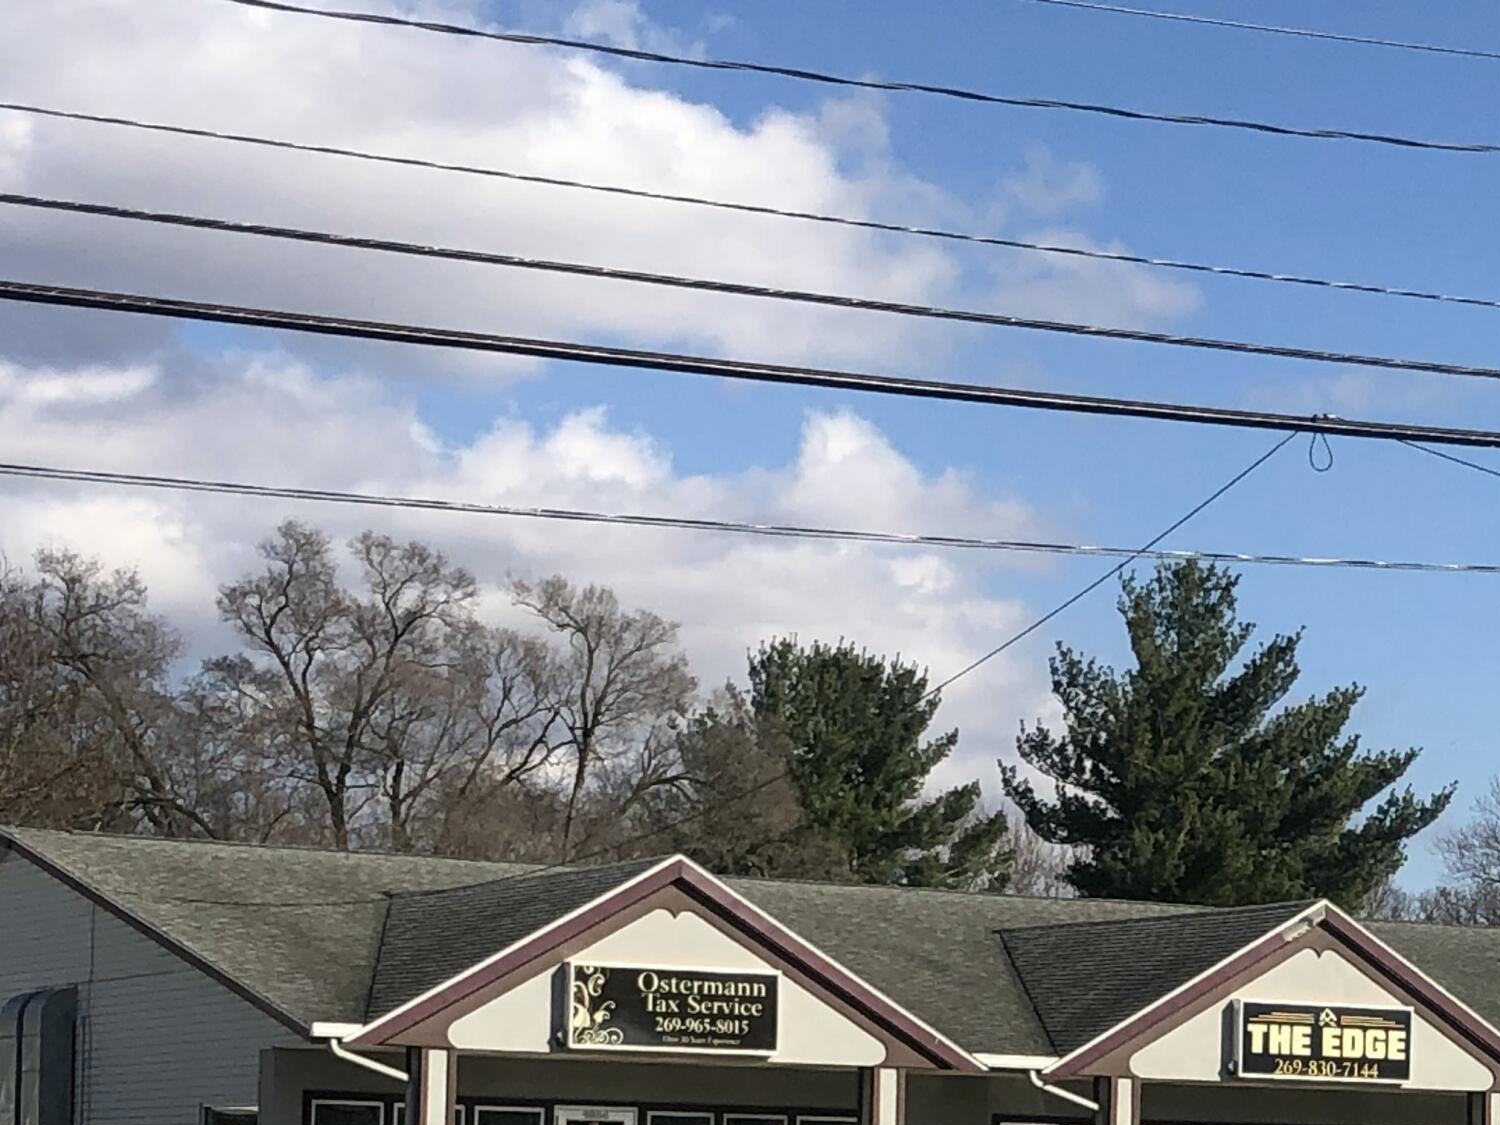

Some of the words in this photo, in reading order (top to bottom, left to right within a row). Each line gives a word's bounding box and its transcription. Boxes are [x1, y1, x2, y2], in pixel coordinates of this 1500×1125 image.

[637, 972, 767, 997] Ostermann
[641, 993, 680, 1013] Tax
[687, 996, 763, 1017] Service
[655, 1017, 750, 1035] 269-965-8015
[1247, 1023, 1312, 1057] THE
[1322, 1027, 1407, 1061] EDGE
[1274, 1058, 1379, 1078] 269-830-7144
